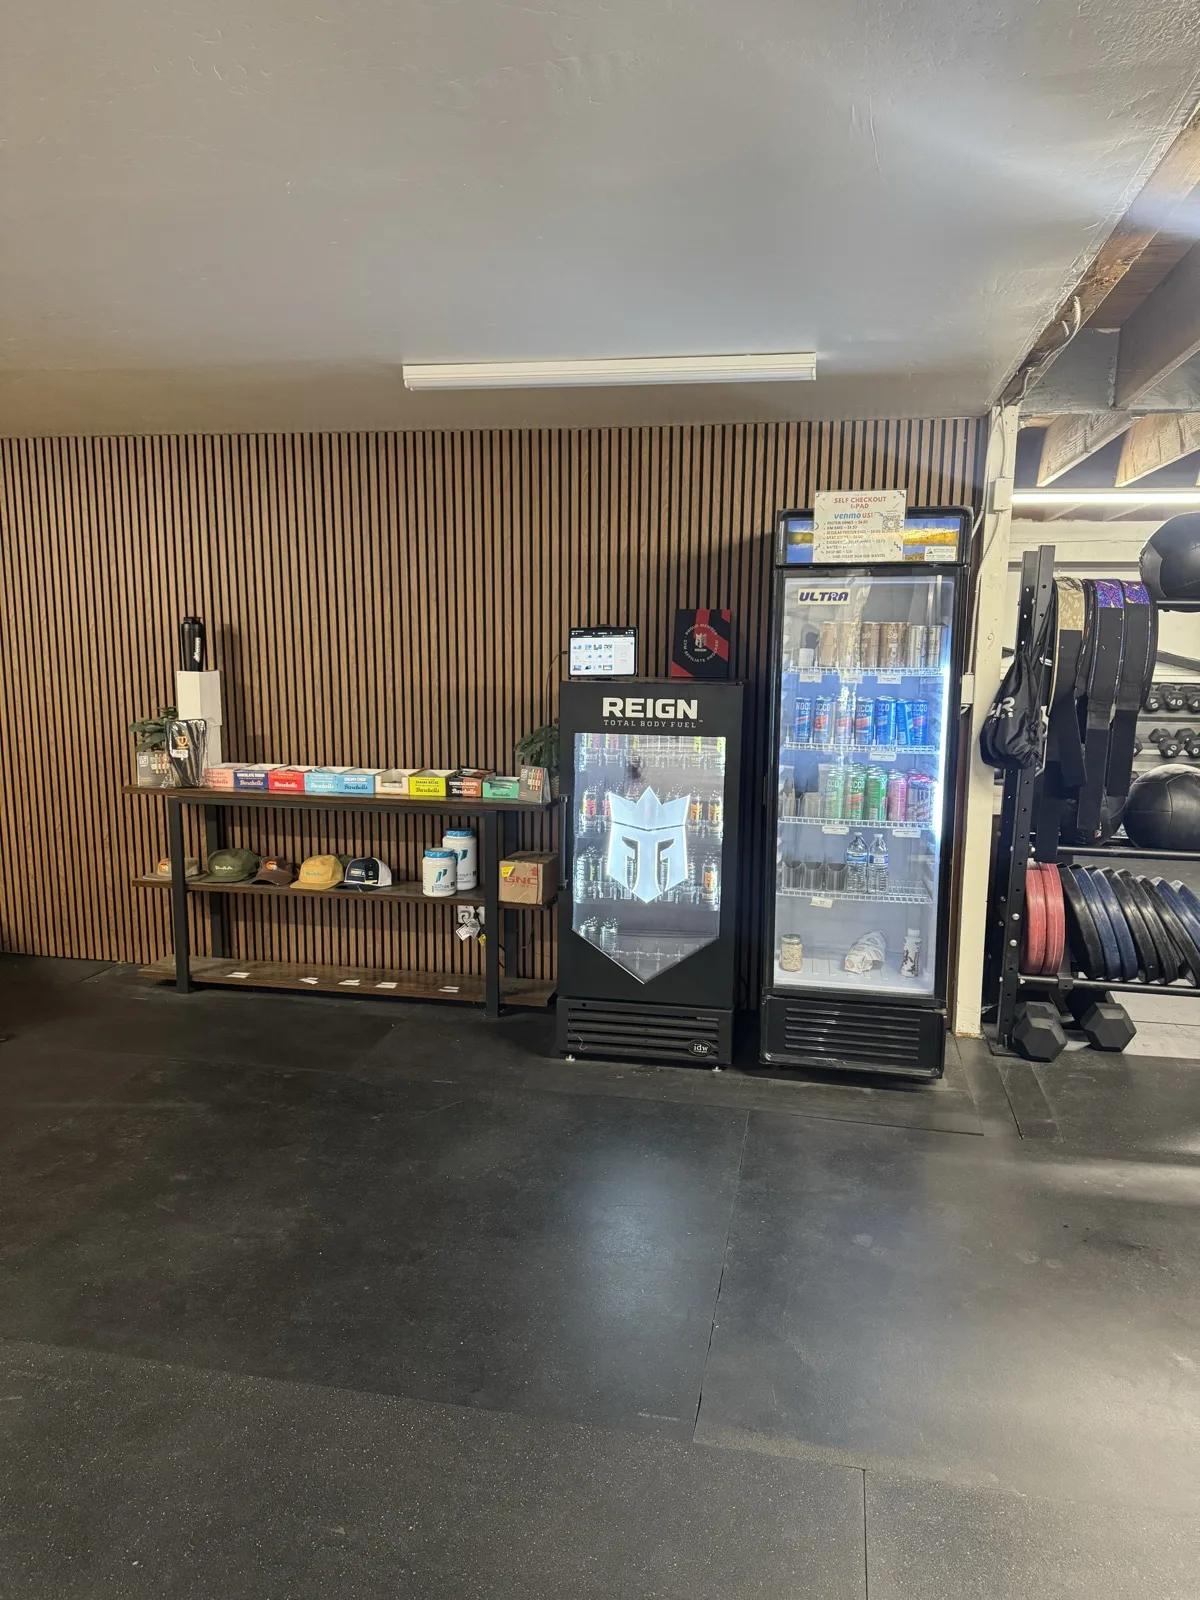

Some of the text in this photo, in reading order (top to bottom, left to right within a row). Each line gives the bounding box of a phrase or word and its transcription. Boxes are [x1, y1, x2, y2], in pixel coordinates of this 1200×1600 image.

[799, 591, 849, 602] ULTRA
[684, 651, 706, 663] AFFILIATE
[602, 697, 698, 720] REIGN
[1149, 698, 1159, 709] 40
[604, 719, 636, 727] TOTAL
[640, 720, 667, 728] BODY
[1167, 744, 1177, 756] 40
[503, 875, 538, 886] GNC
[693, 1043, 709, 1051] idw
